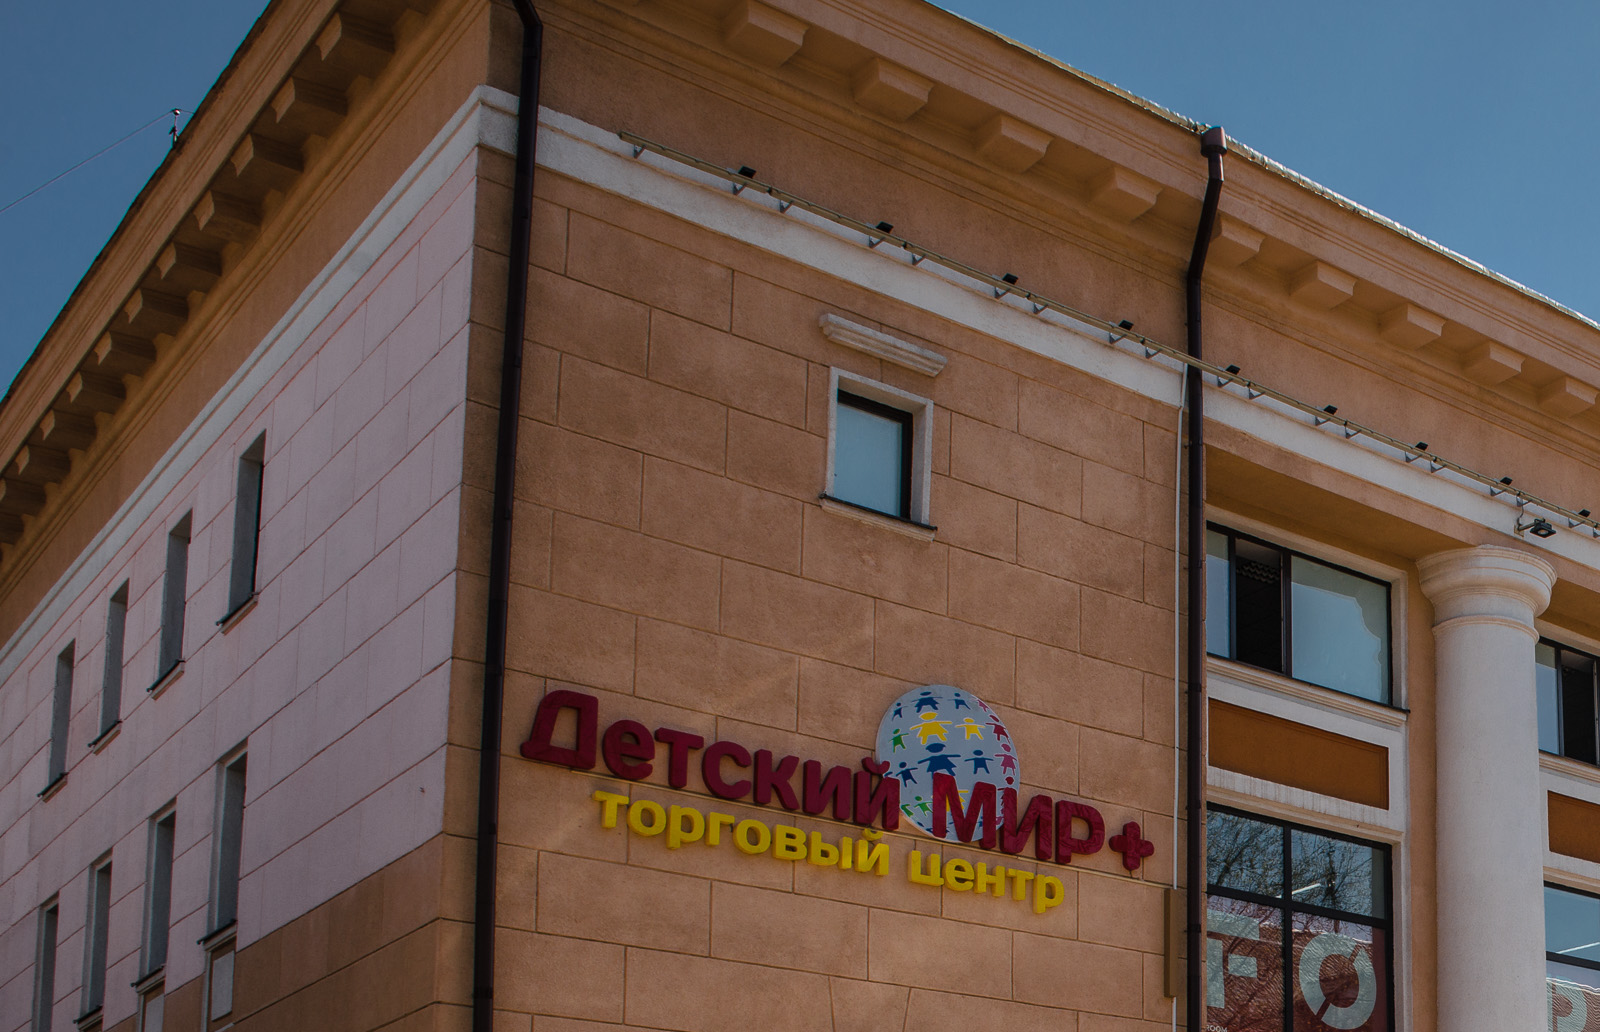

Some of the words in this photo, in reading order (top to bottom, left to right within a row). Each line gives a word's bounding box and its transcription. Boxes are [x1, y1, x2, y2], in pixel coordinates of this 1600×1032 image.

[521, 690, 900, 831] Детский
[592, 790, 889, 877] торговый
[907, 850, 1065, 914] центр
